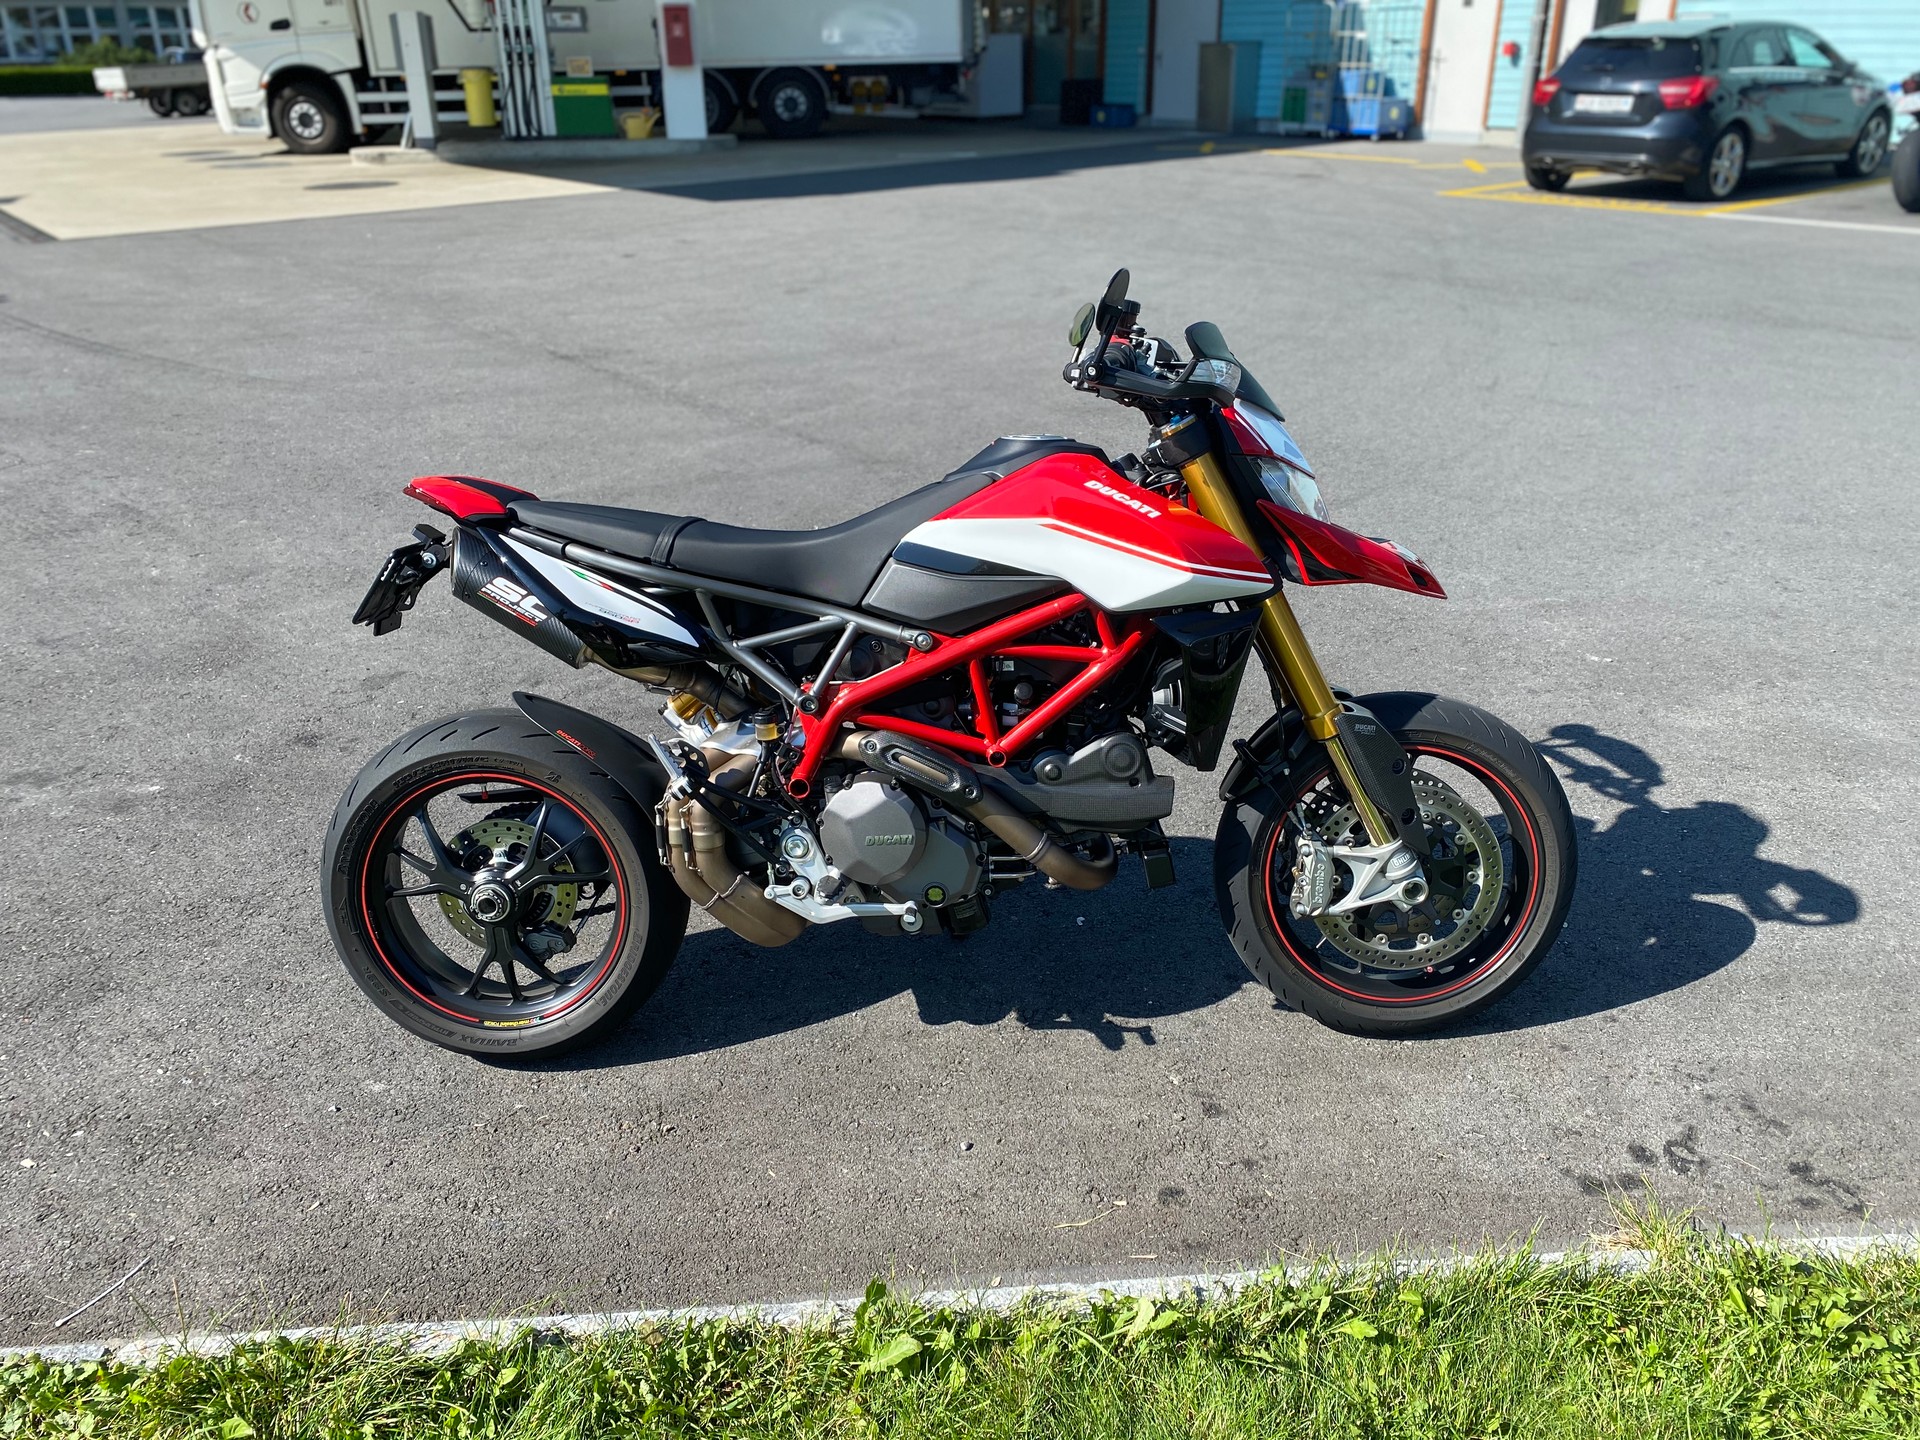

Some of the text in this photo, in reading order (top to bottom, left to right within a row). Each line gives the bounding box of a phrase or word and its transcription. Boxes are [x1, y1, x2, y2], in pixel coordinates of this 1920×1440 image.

[1083, 479, 1162, 518] DUCATI
[480, 587, 543, 622] PROJECT
[556, 729, 582, 747] DUCATI
[865, 834, 914, 847] DUCATI
[1312, 863, 1325, 904] brembo
[600, 929, 643, 1007] BRIDGESTONE
